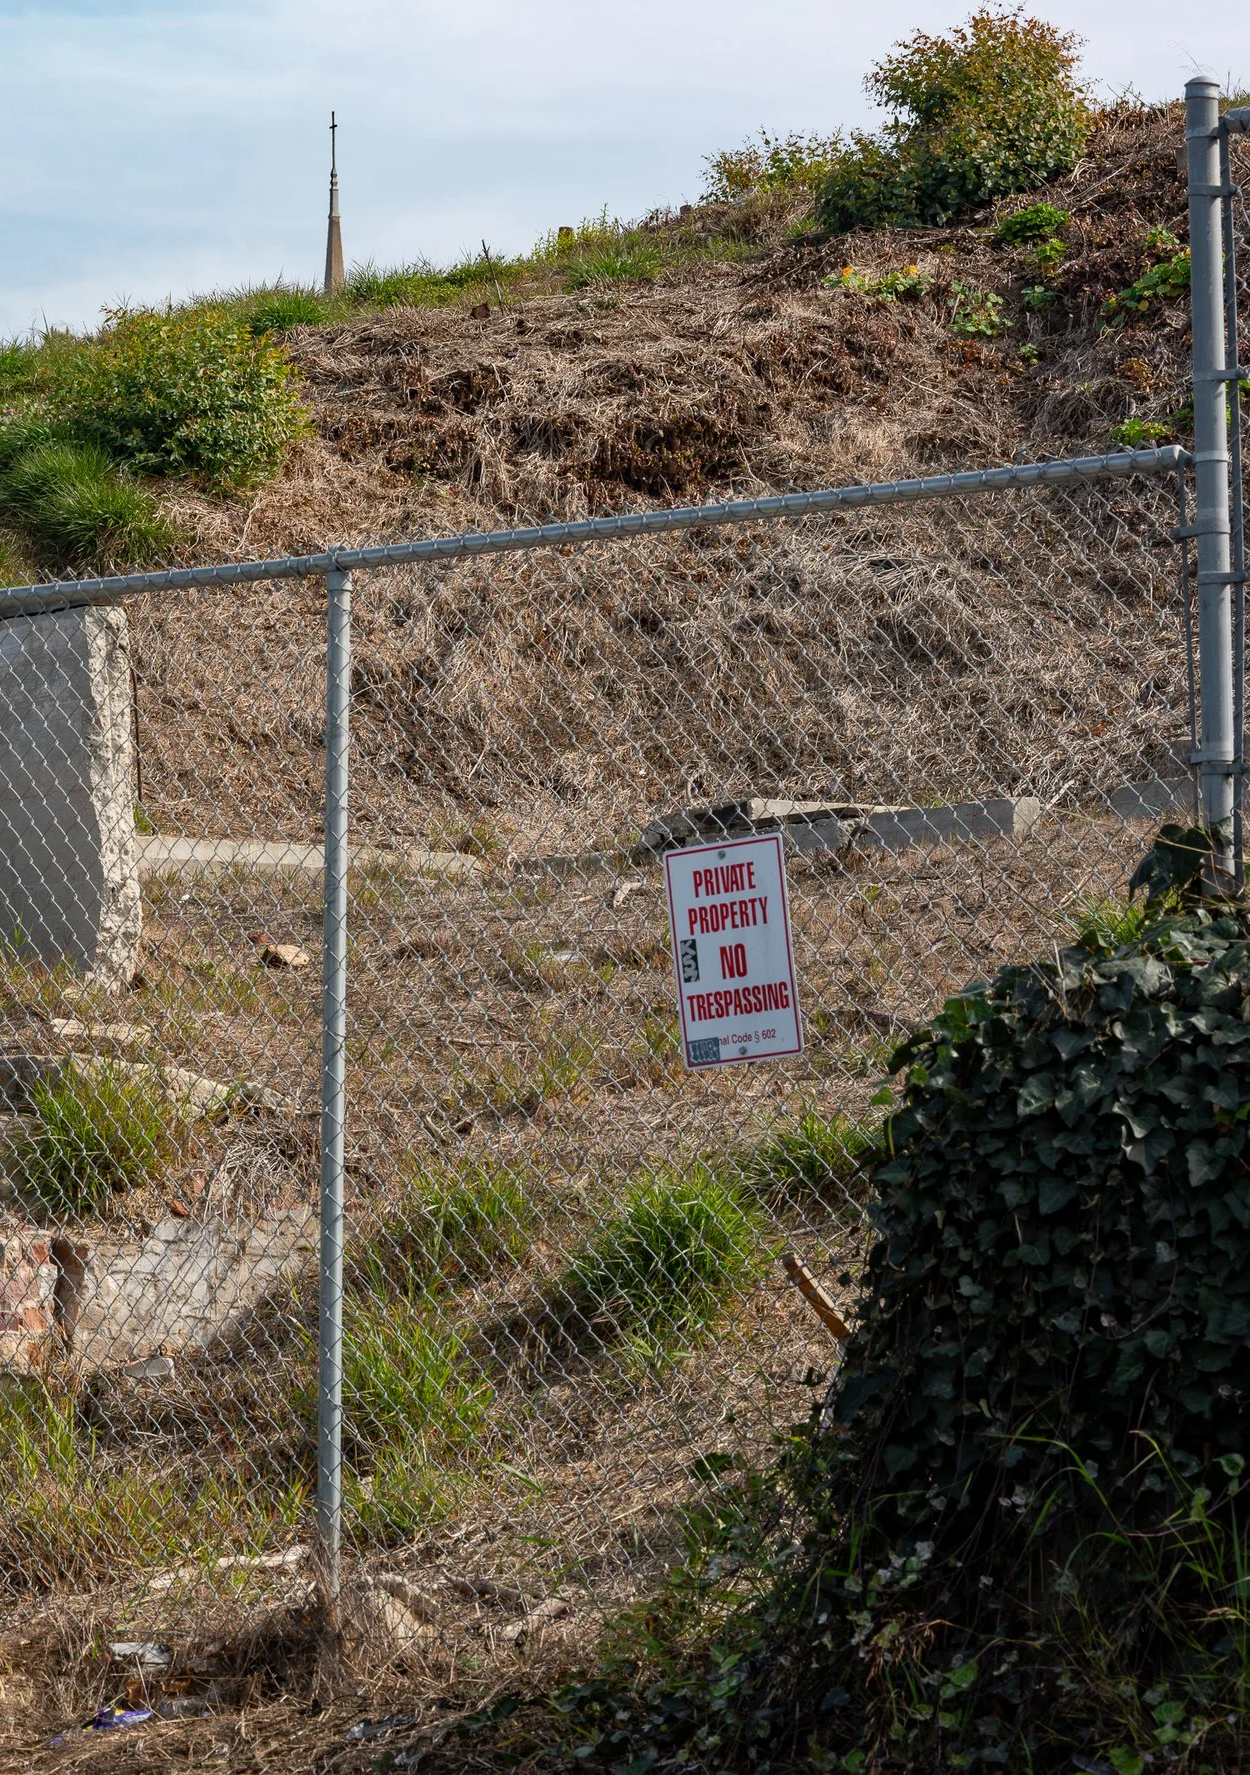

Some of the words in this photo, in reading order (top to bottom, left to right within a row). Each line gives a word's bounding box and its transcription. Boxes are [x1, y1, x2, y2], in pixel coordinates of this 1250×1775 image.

[693, 861, 756, 897] PRIVATE
[688, 896, 768, 935] PROPERTY
[720, 943, 747, 980] NO
[687, 981, 790, 1022] TRESPASSING
[718, 1036, 730, 1046] nal
[731, 1032, 753, 1044] Code
[754, 1030, 760, 1043] §
[761, 1028, 777, 1040] 602
